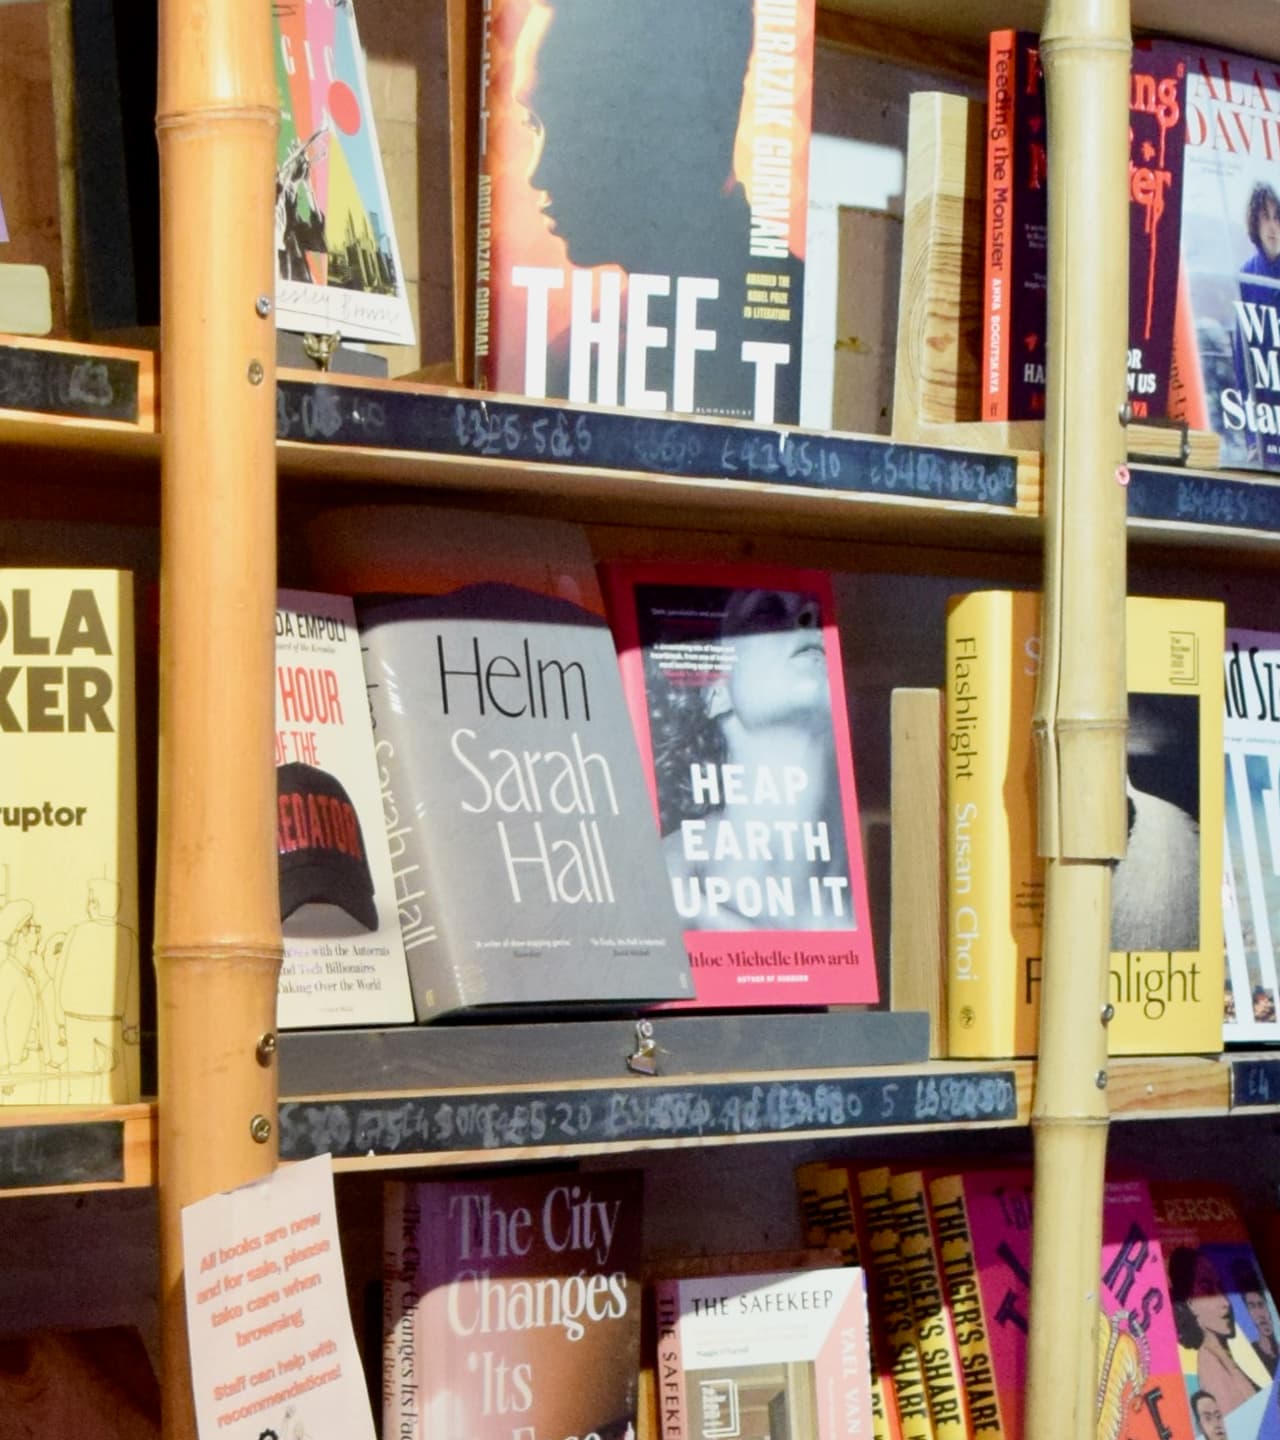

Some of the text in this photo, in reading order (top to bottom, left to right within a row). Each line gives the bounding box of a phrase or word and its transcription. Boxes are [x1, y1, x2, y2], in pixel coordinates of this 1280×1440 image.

[748, 135, 792, 259] GURNAH
[436, 634, 591, 723] Helm
[450, 728, 620, 817] Sarah
[689, 763, 808, 804] HEAP
[681, 819, 831, 862] EARTH
[948, 635, 980, 984] Flashlight Susan Choi
[498, 821, 617, 905] Hall
[672, 877, 848, 918] UPON IT
[199, 1251, 217, 1274] All
[219, 1238, 261, 1264] books
[264, 1224, 288, 1245] are
[448, 1186, 619, 1264] The City
[196, 1239, 330, 1305] and for sale, please
[211, 1273, 322, 1328] take care when
[445, 1268, 629, 1340] Changes
[691, 1289, 834, 1318] THE SAFEKEEP
[213, 1339, 337, 1401] Staff can help with
[217, 1365, 342, 1428] recommendations!
